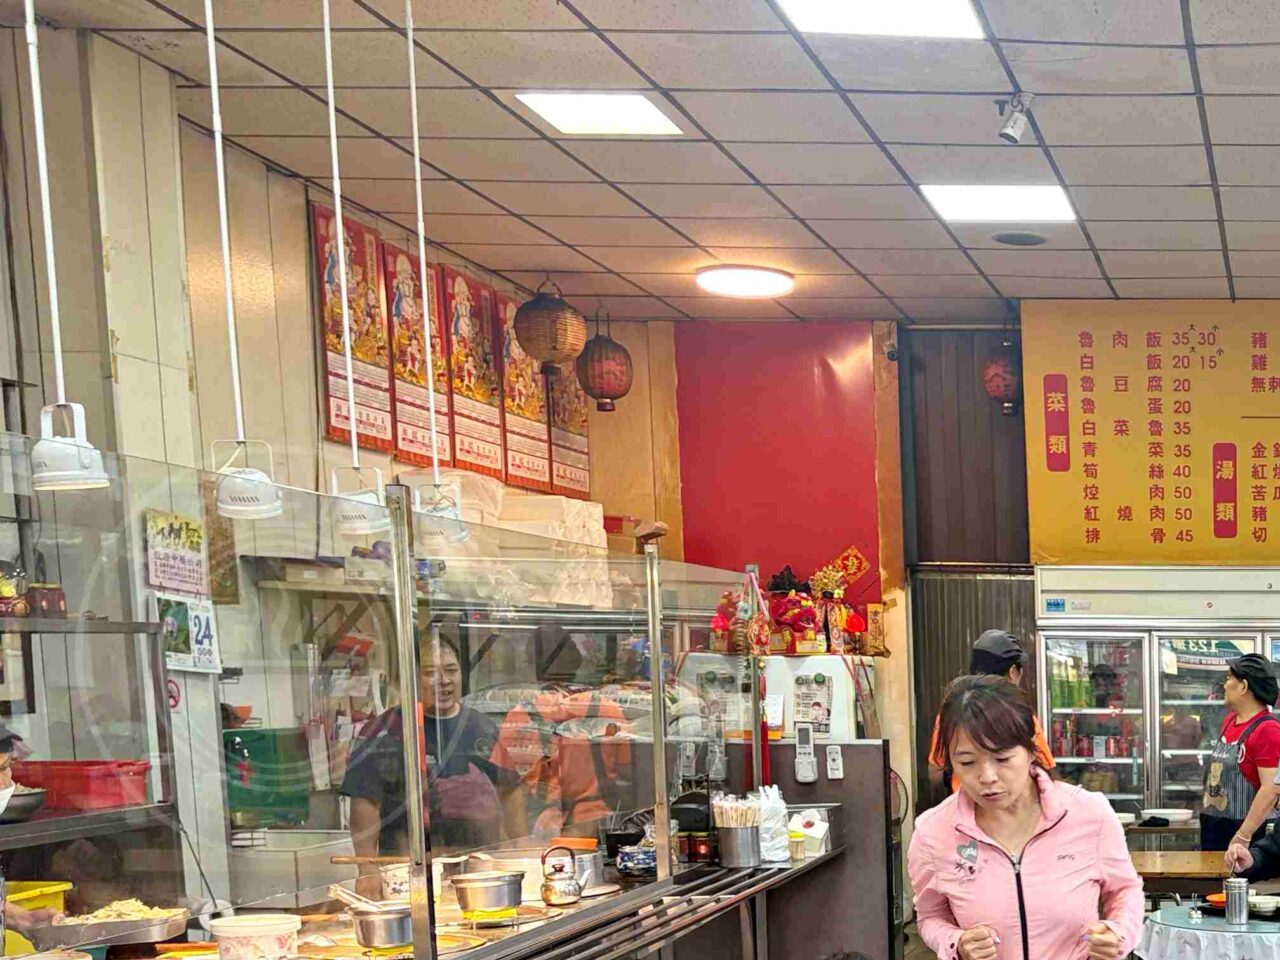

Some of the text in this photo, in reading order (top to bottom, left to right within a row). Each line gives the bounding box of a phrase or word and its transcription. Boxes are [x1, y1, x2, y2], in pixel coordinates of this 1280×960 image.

[1078, 331, 1161, 348] 魯肉飯
[1172, 332, 1190, 345] 35
[1198, 332, 1216, 345] 30
[1080, 353, 1162, 370] 白飯
[1173, 355, 1190, 369] 20
[1200, 355, 1217, 369] 15
[1080, 376, 1190, 392] 魯豆腐 20
[1081, 398, 1191, 414] 魯蛋 20
[1047, 393, 1068, 455] 菜類
[1083, 420, 1191, 436] 白菜魯 35
[1082, 441, 1191, 458] 青菜 35
[1173, 465, 1191, 478] 40
[1174, 487, 1191, 499] 50
[1215, 460, 1235, 521] 湯類
[1084, 506, 1192, 521] 紅燒肉 50
[1086, 528, 1193, 543] 排骨 45
[194, 614, 214, 647] 24
